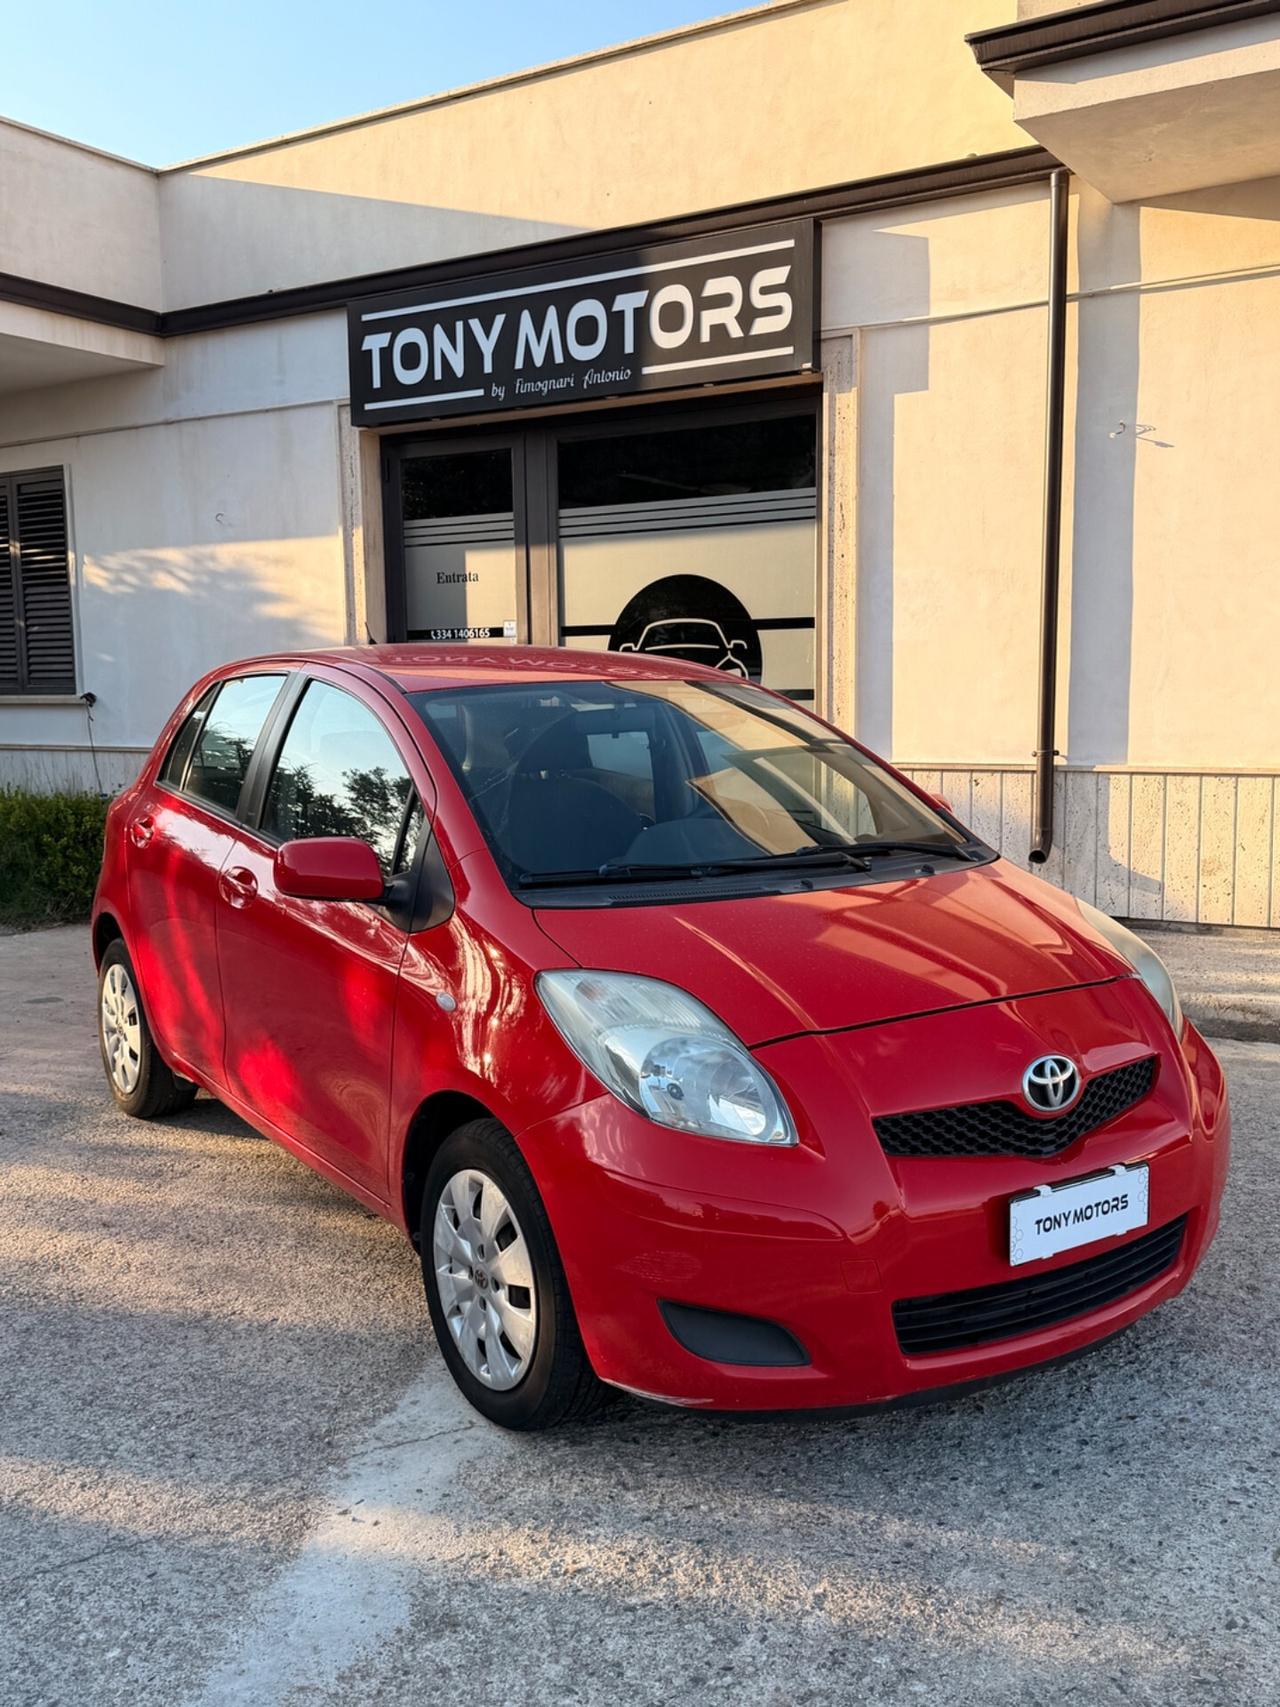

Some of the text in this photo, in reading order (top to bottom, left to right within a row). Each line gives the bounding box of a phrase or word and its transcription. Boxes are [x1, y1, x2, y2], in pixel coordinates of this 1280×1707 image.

[361, 264, 794, 389] TONY MOTORS
[491, 382, 506, 401] by
[582, 366, 632, 389] Antonio
[436, 571, 479, 584] Entrata
[436, 628, 491, 640] 334 1406165
[1034, 1193, 1129, 1235] TONY MOTORS
